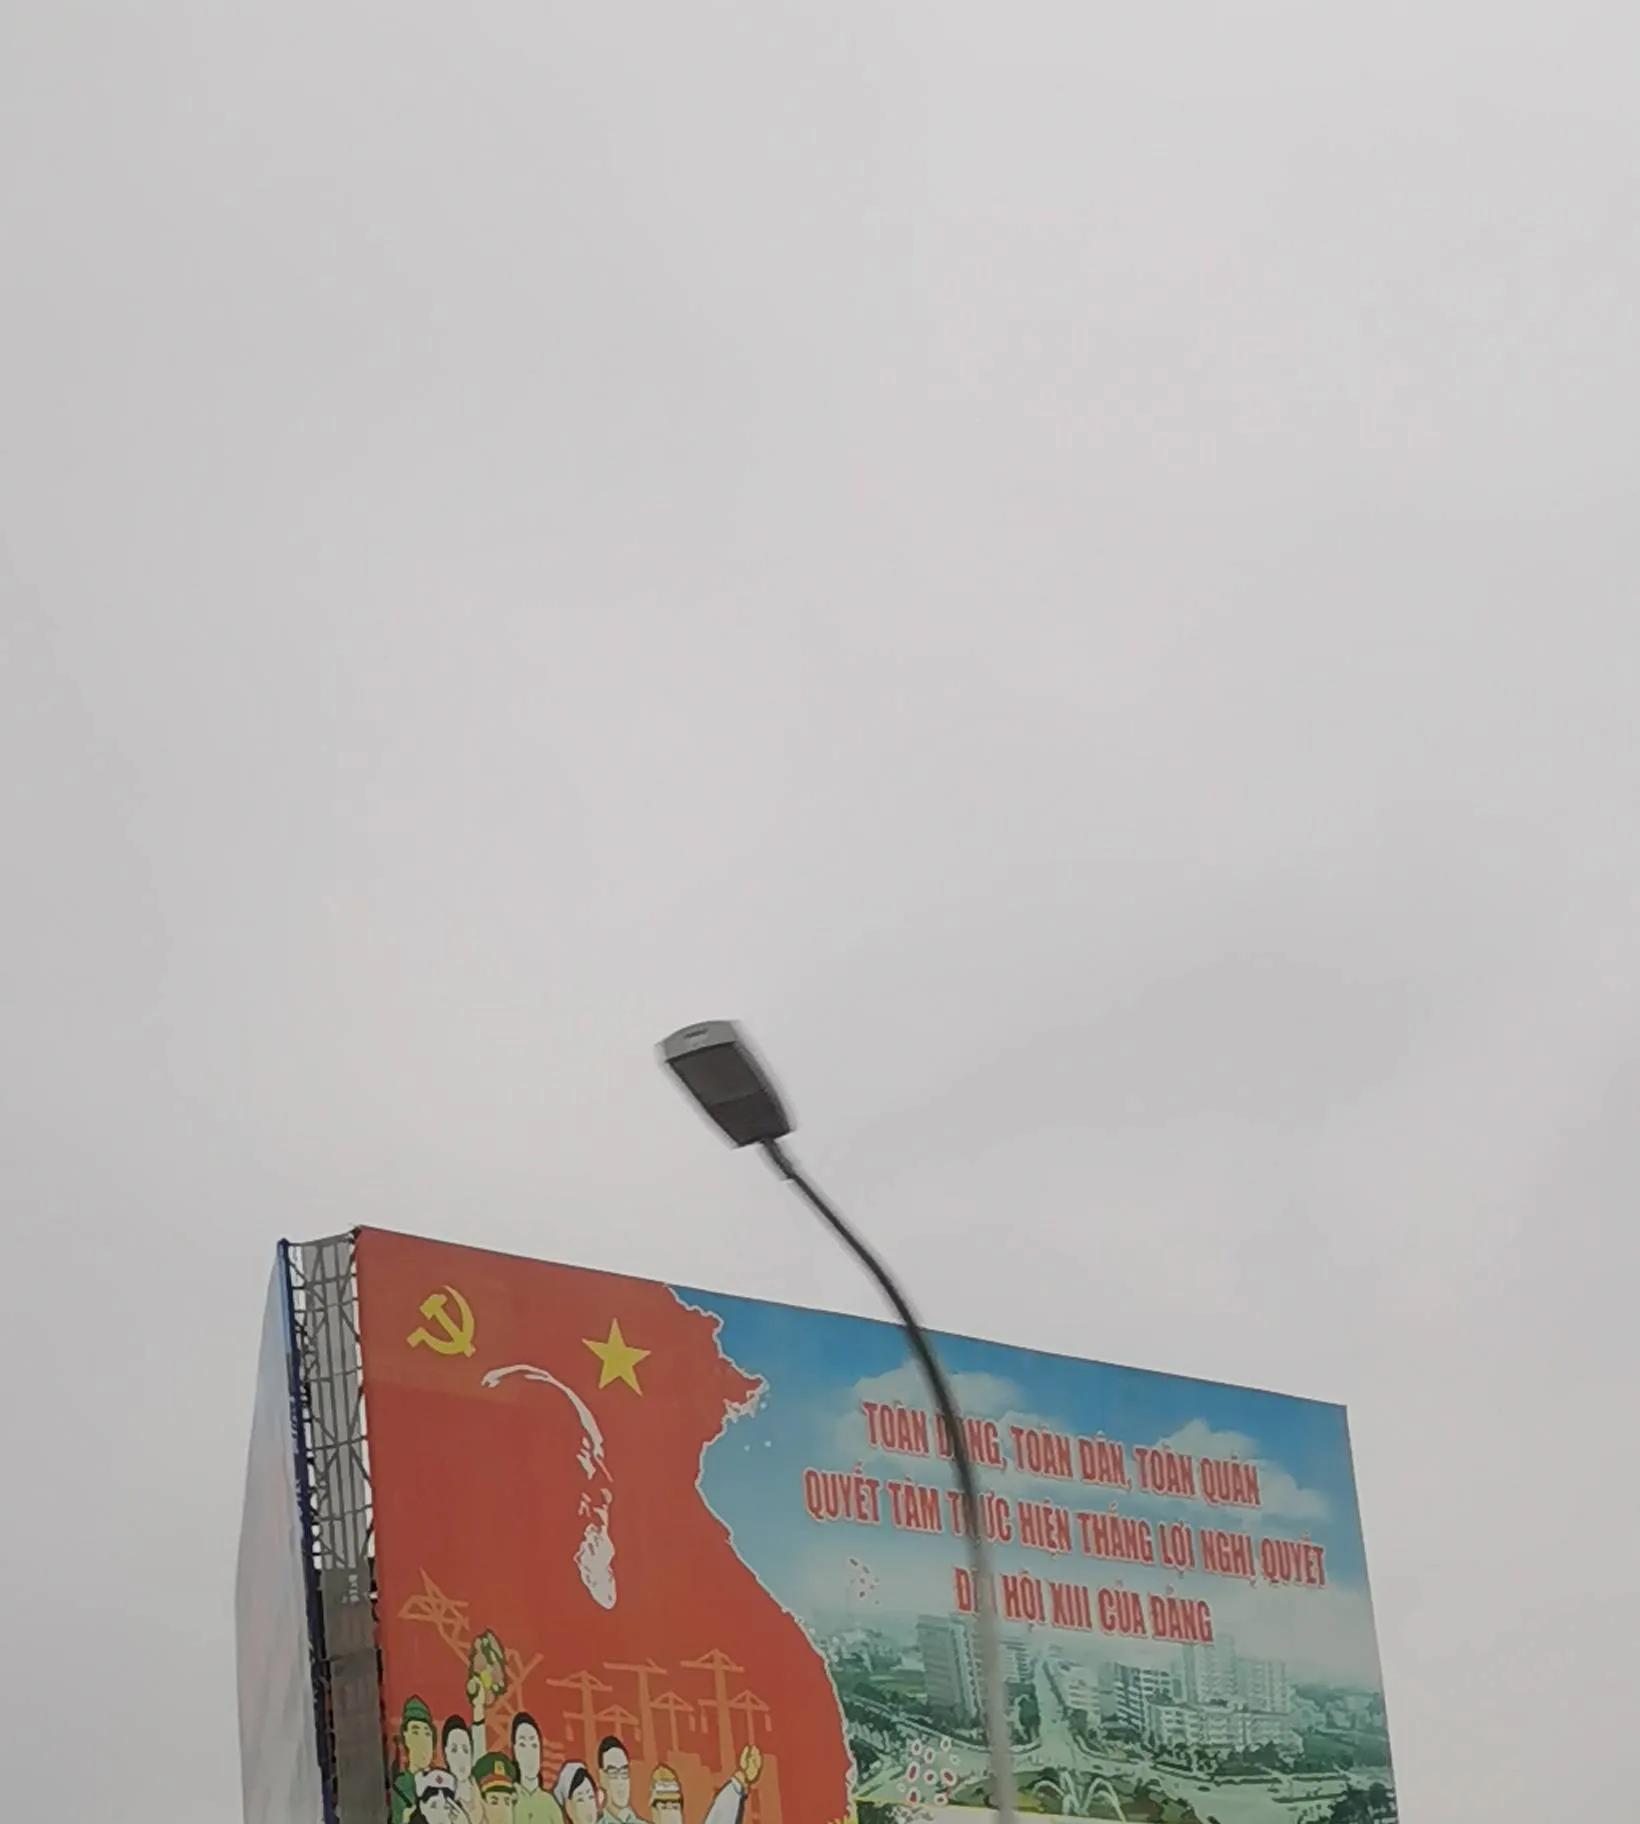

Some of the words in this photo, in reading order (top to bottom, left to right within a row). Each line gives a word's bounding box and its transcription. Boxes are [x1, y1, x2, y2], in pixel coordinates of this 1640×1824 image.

[862, 1401, 930, 1453] TOÀN
[1010, 1425, 1073, 1478] TOÀN
[1078, 1431, 1132, 1491] DÂN,
[1134, 1443, 1195, 1496] TOÀN
[1200, 1454, 1261, 1506] QUÂN
[803, 1461, 880, 1521] QUYẾT
[1016, 1498, 1073, 1558] HIỆN
[1075, 1503, 1154, 1563] THẮNG
[1159, 1520, 1196, 1579] LỢI
[1201, 1529, 1256, 1587] NGHỊ
[1261, 1531, 1327, 1586] QUYẾT
[1002, 1570, 1046, 1632] HỘI
[1048, 1581, 1093, 1629] XIII
[1098, 1579, 1147, 1635] CỦA
[1148, 1584, 1214, 1643] ĐẢNG
